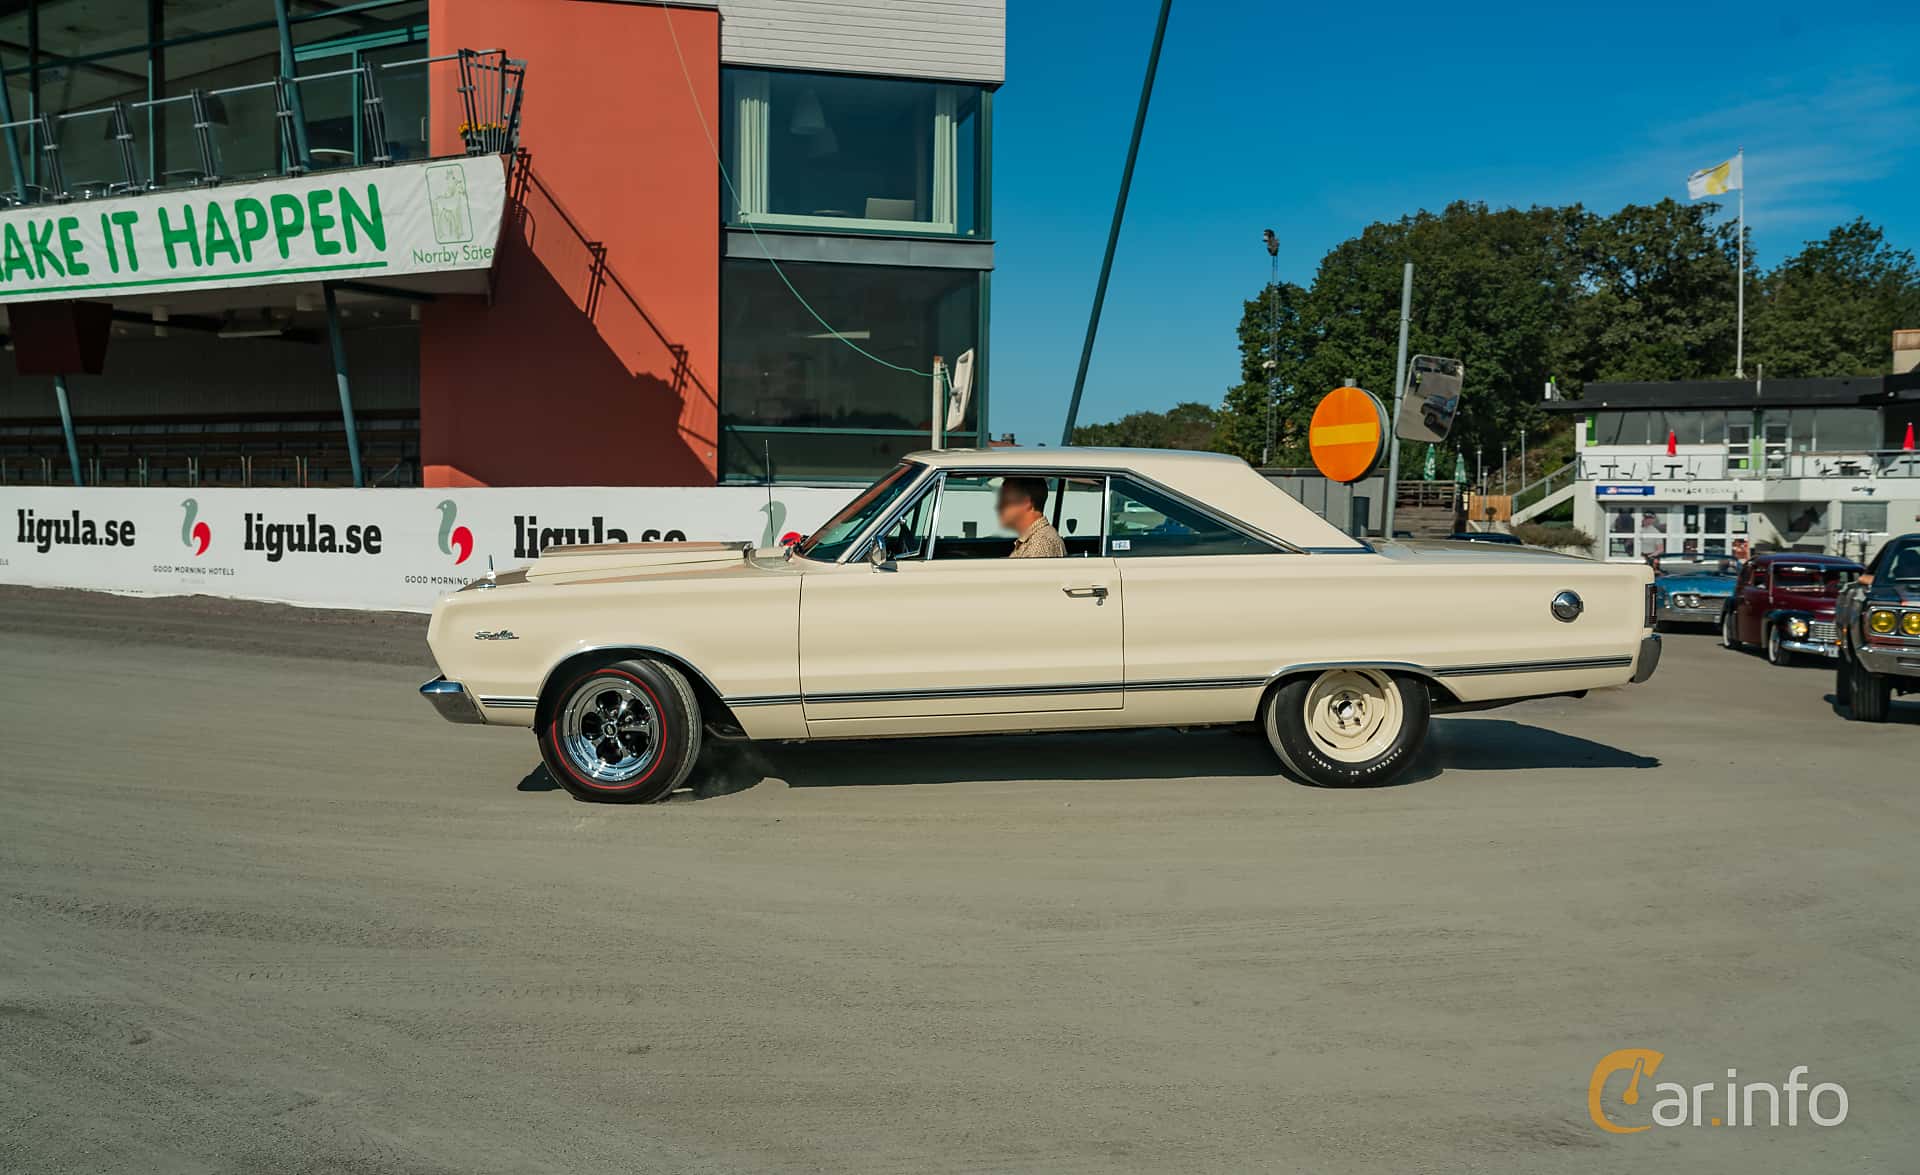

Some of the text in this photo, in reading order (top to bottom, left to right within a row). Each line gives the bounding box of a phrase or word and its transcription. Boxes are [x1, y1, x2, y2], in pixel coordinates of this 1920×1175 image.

[0, 183, 387, 283] AKE IT HAPPEN
[412, 246, 459, 266] Norrby
[17, 508, 136, 554] ligula.se
[244, 513, 382, 562] ligula.se
[153, 565, 235, 576] GOOD MORNING HOTELS
[404, 575, 428, 584] GOOD
[431, 576, 469, 586] MORNING
